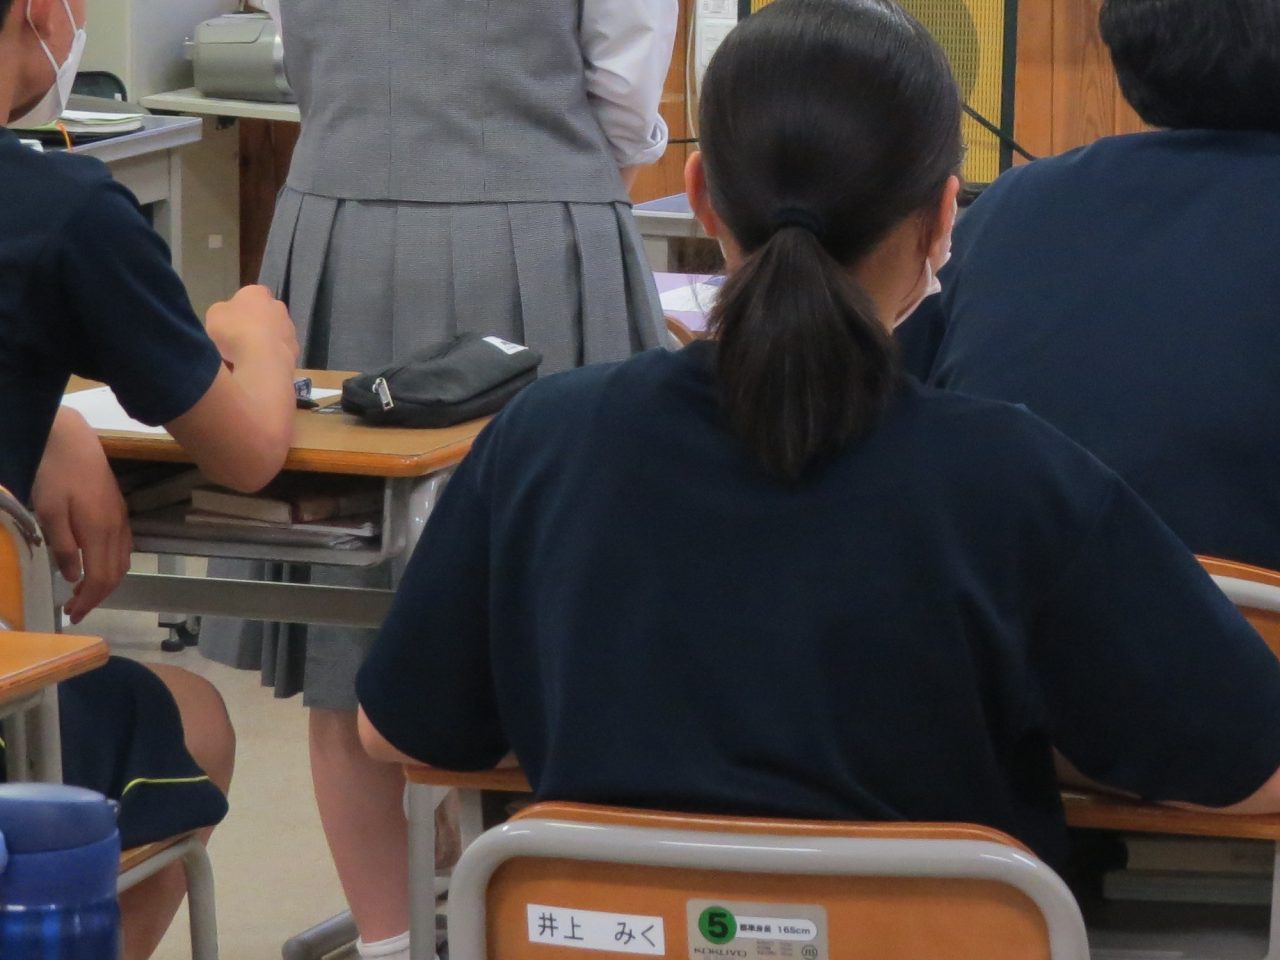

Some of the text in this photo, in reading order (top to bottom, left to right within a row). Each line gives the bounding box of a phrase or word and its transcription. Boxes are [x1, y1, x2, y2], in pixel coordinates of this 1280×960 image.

[538, 912, 656, 948] 井上 みく
[707, 911, 730, 939] 5
[777, 926, 811, 935] 165cm
